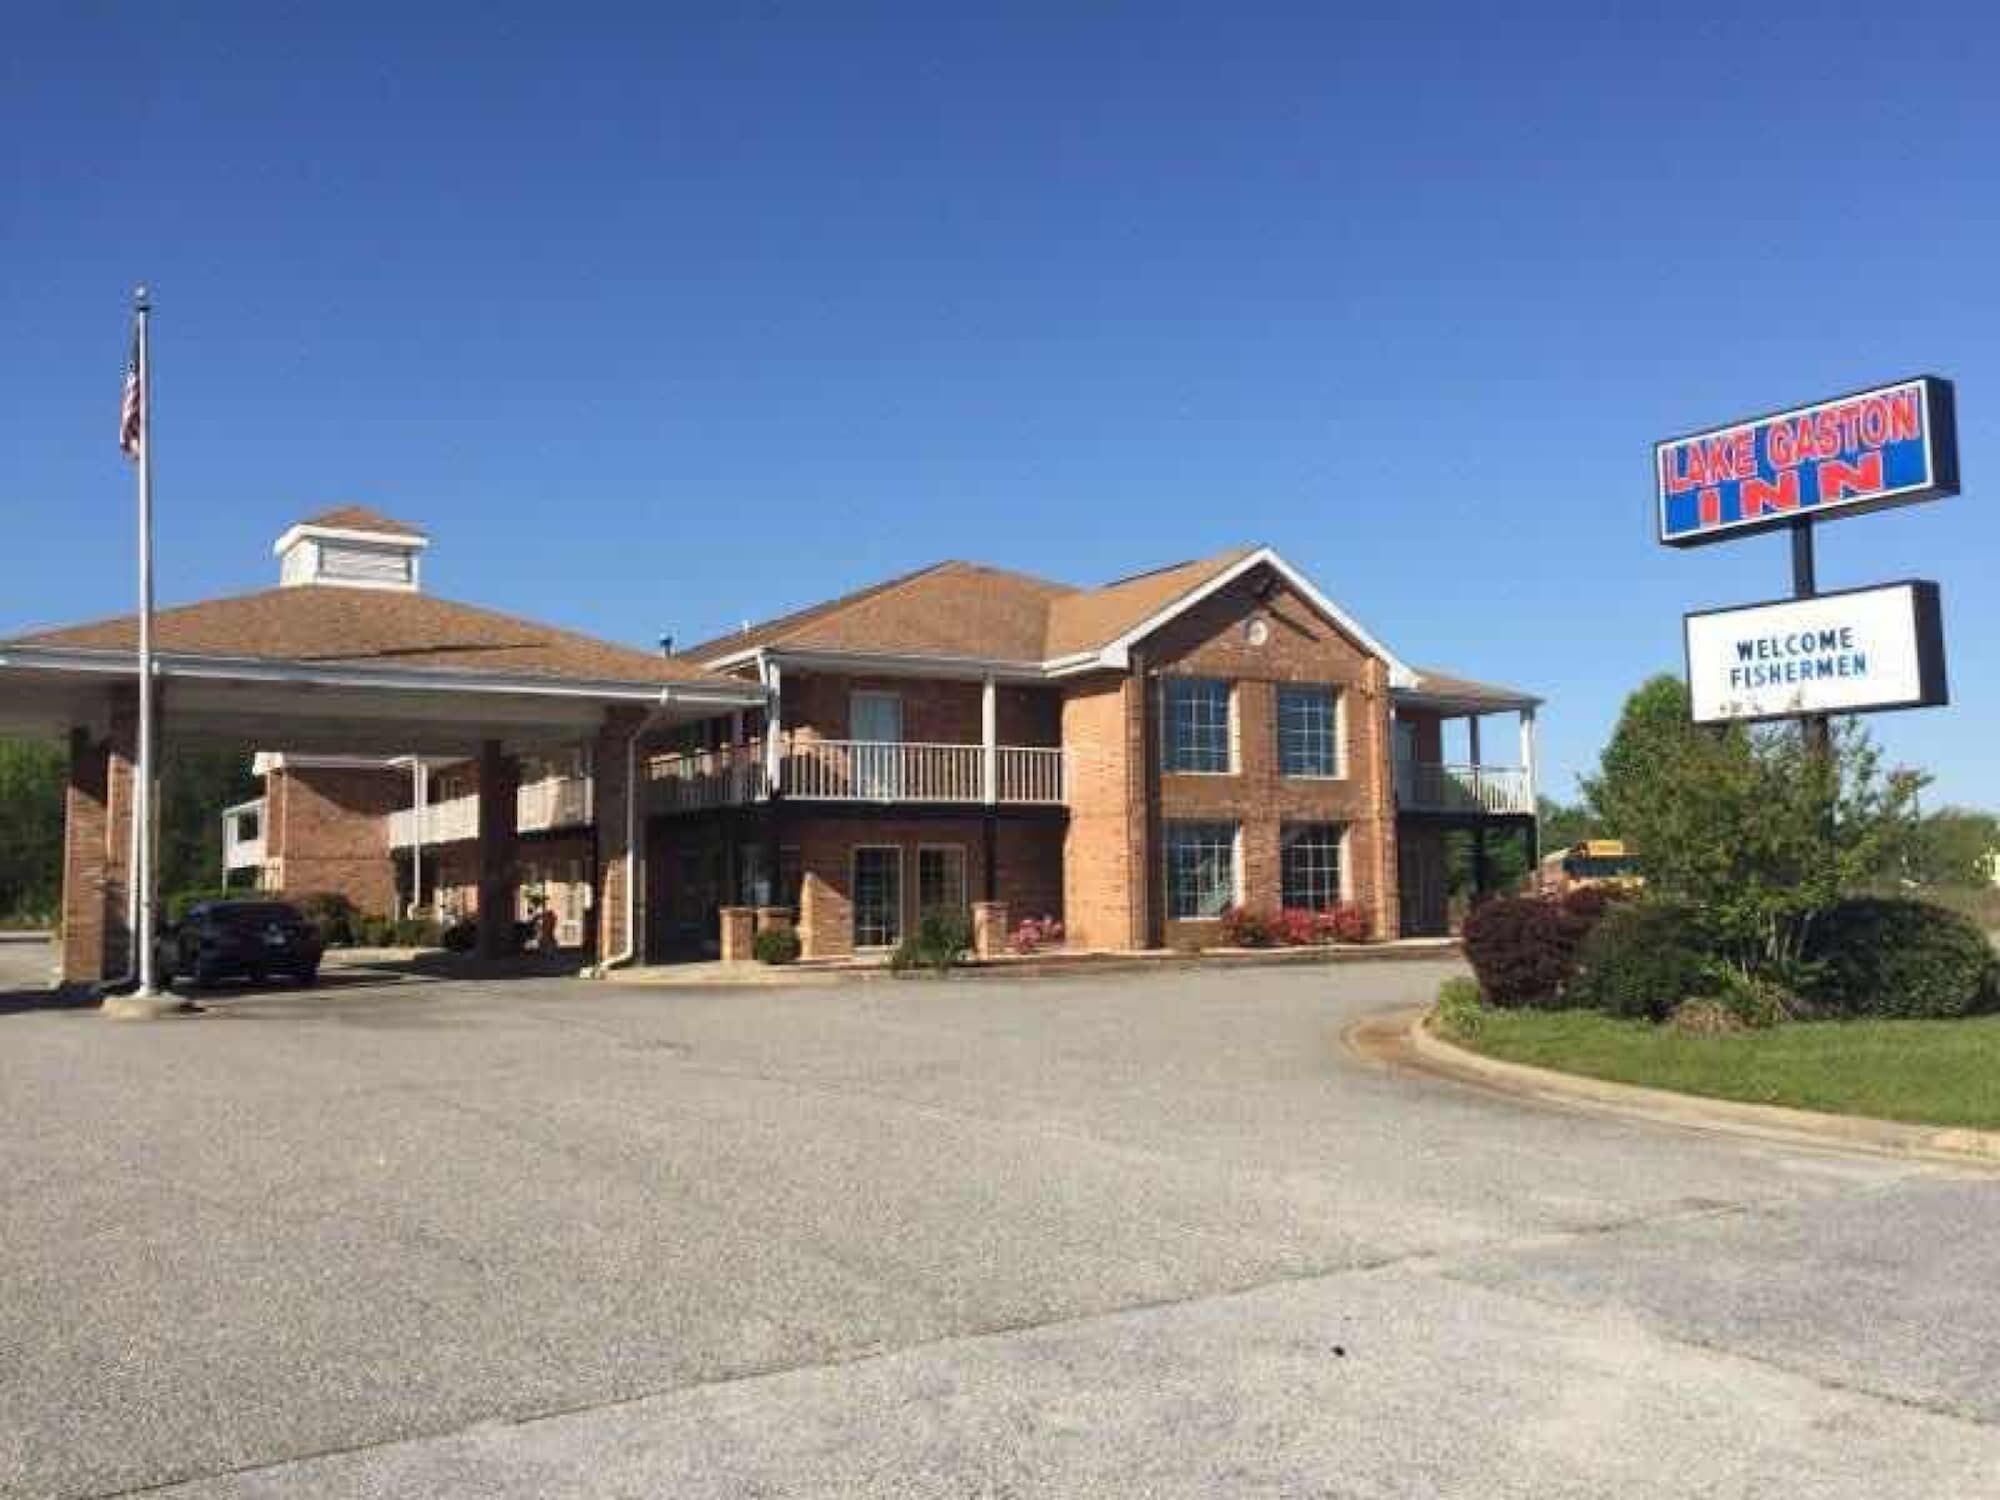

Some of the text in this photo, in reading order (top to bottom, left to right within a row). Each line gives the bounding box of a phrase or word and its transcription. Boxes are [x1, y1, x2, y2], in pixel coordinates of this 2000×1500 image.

[1664, 388, 1920, 492] LAKE GASTON
[1699, 449, 1883, 528] INN
[1729, 652, 1867, 689] FISHERMEN
[1737, 627, 1854, 661] WELCOME
